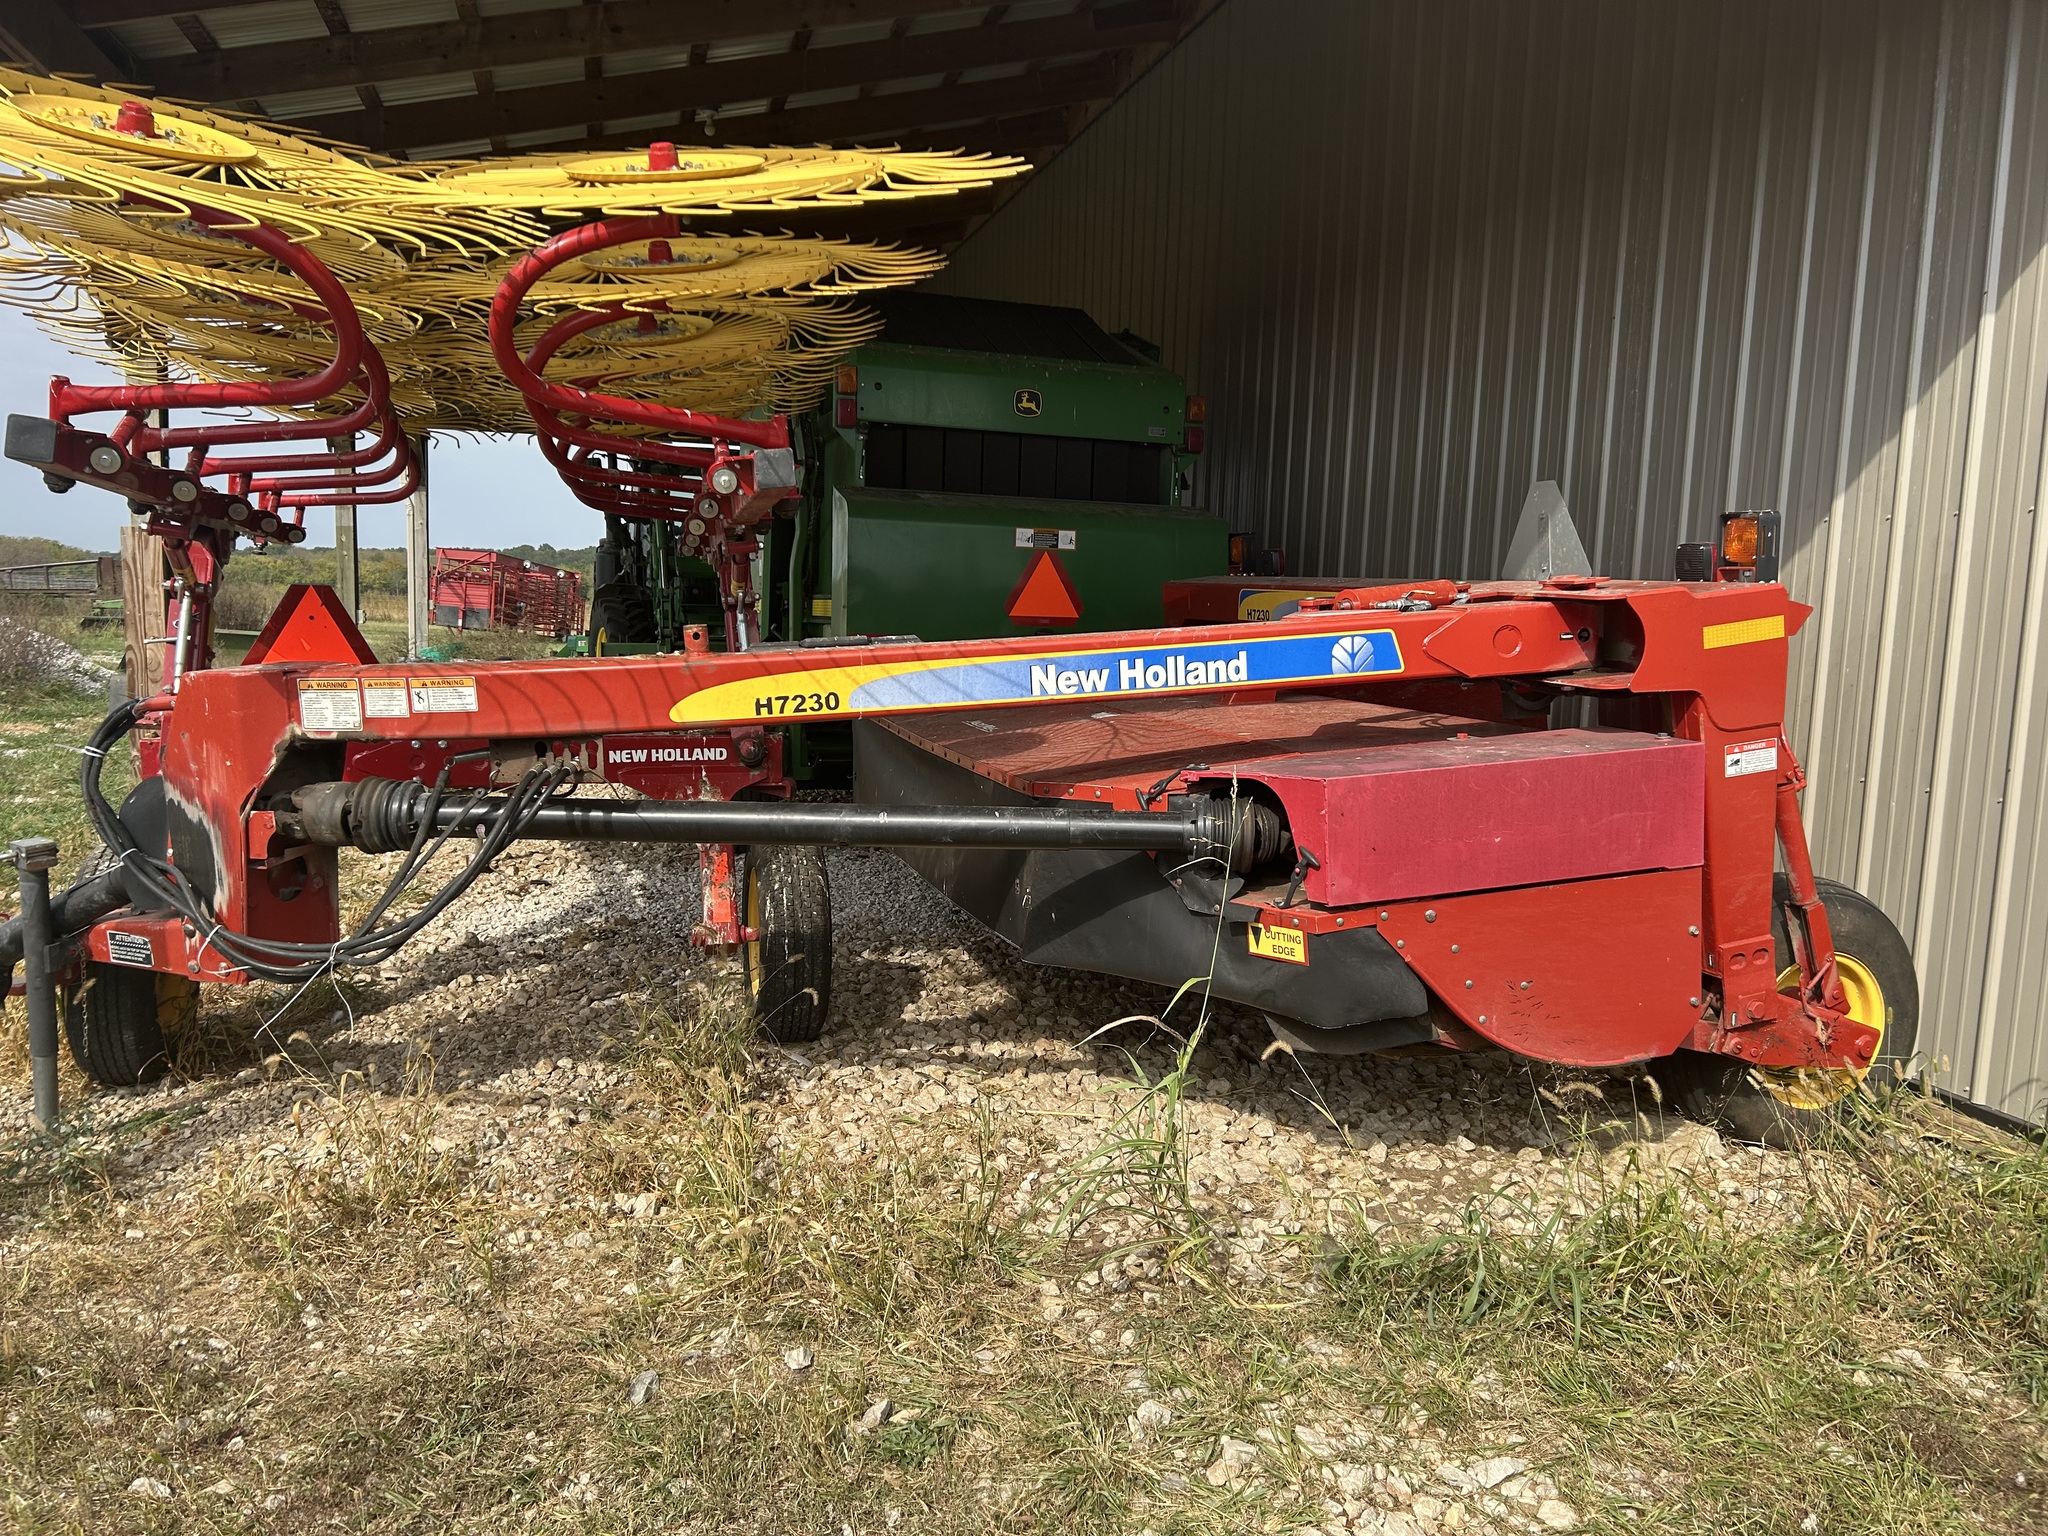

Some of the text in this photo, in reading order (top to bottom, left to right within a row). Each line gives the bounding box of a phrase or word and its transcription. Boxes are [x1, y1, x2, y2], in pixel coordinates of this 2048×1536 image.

[1247, 608, 1270, 621] H7230
[1029, 650, 1248, 696] New Holland
[755, 692, 840, 716] H7230
[1743, 742, 1767, 751] DANGER
[608, 748, 727, 763] NEW HOLLAND
[115, 935, 144, 944] ATTENTION
[1264, 931, 1302, 944] CUTTING
[1272, 944, 1296, 957] EDGE
